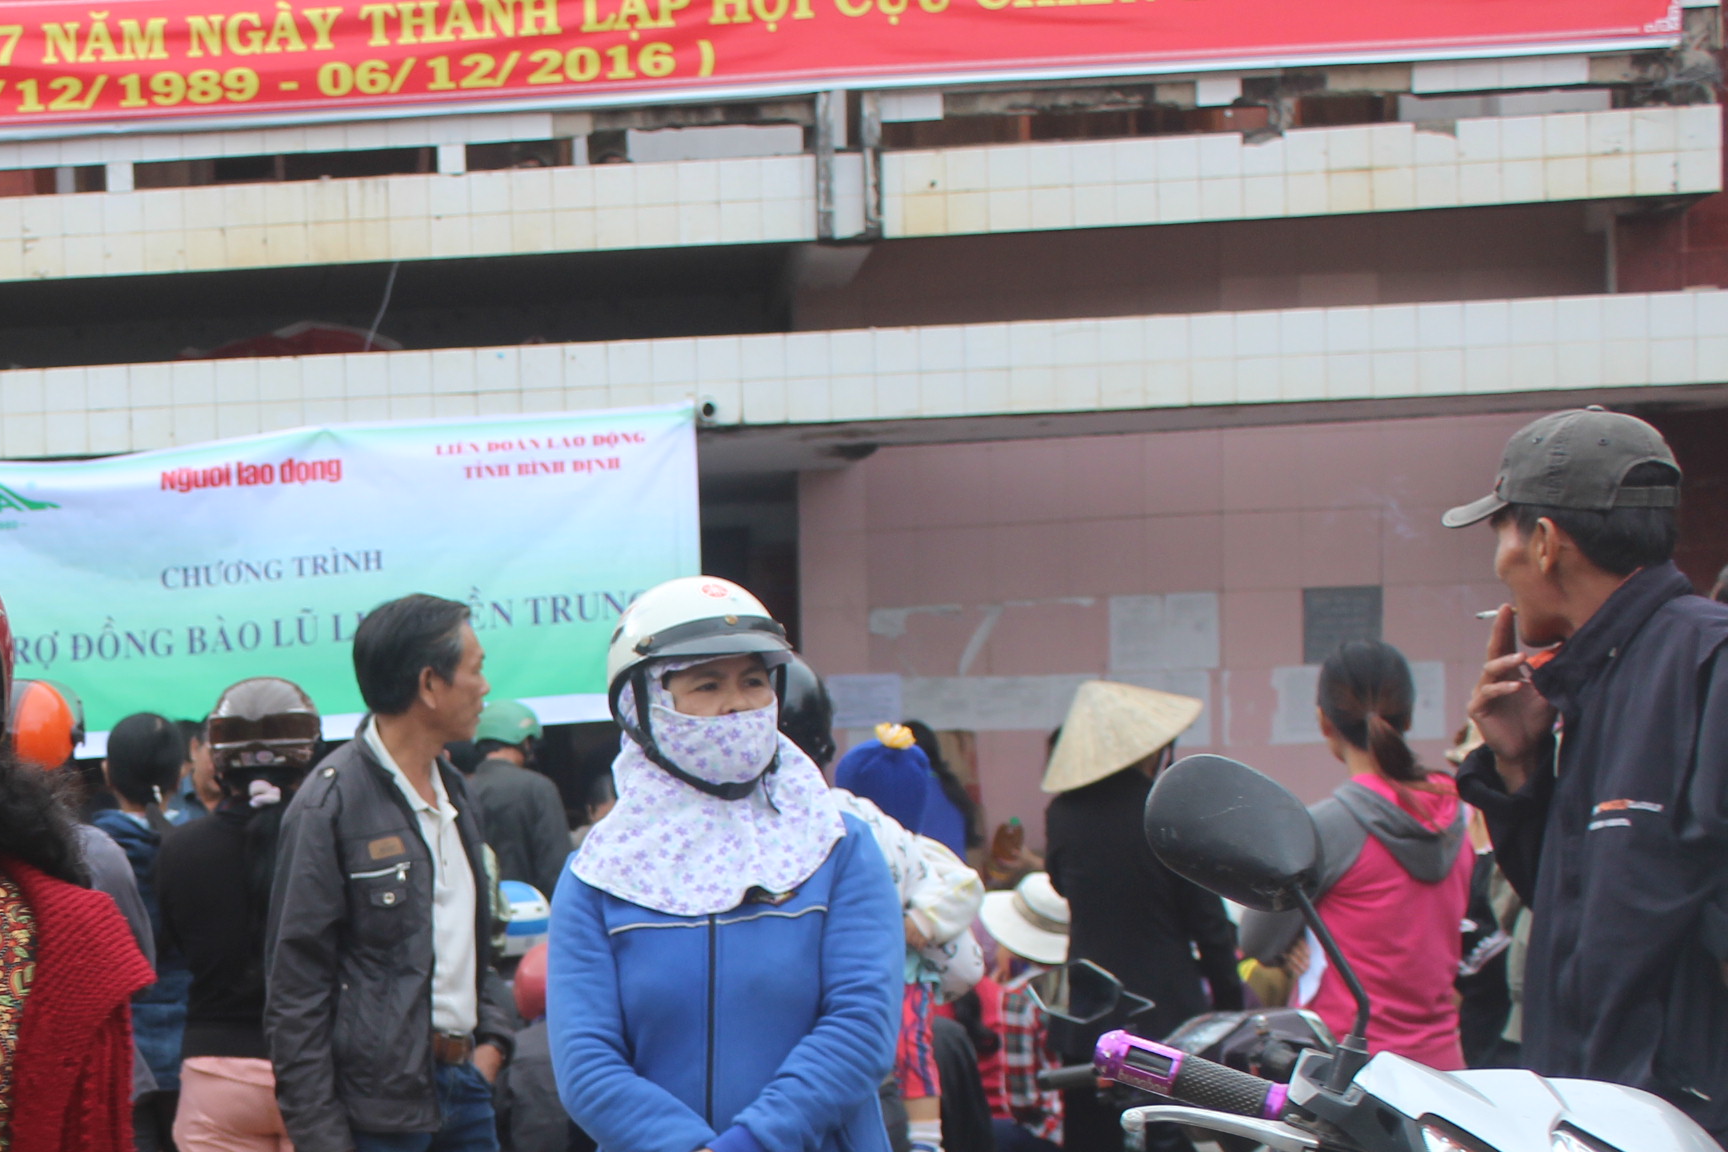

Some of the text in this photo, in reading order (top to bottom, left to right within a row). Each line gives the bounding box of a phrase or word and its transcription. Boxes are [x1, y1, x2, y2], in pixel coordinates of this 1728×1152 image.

[41, 11, 169, 65] NĂM
[186, 1, 343, 57] NGÀY
[161, 547, 383, 590] CHƯƠNG TRÌNH
[13, 630, 59, 670] RỢ
[71, 615, 173, 663] ĐỒNG
[187, 614, 262, 656] BÀO
[272, 608, 319, 649] LŨ
